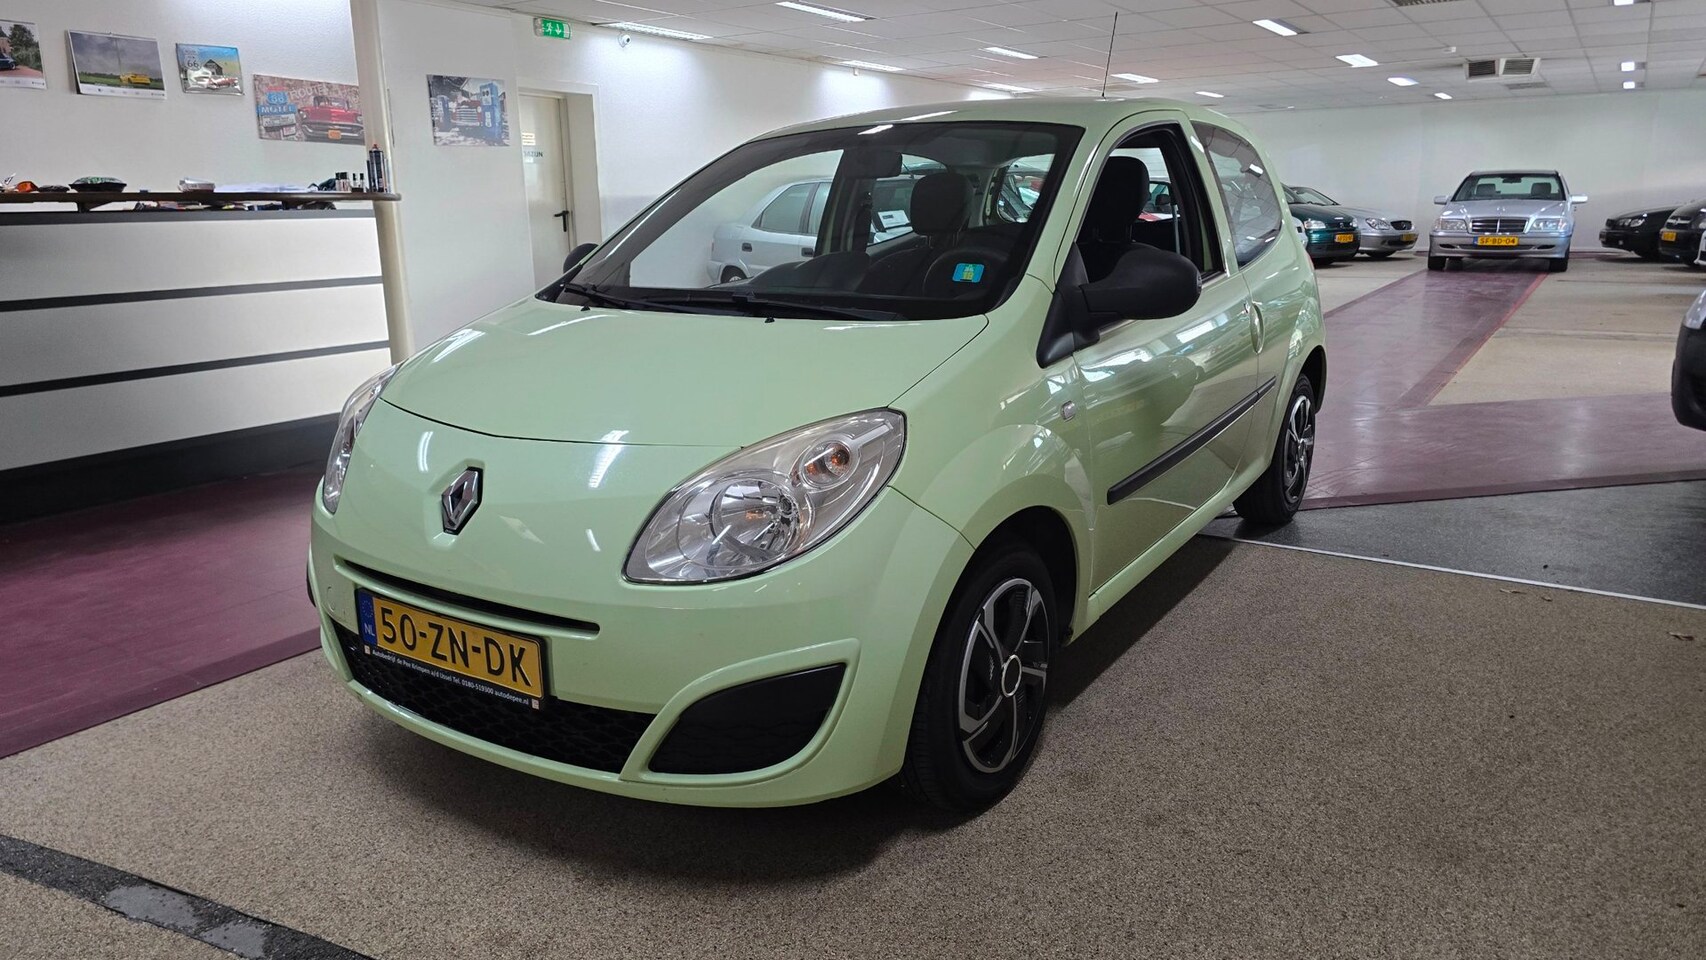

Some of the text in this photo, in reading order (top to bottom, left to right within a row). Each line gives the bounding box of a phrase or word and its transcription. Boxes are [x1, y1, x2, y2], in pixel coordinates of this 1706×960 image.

[187, 59, 200, 68] 66
[261, 105, 293, 114] MOTEL
[364, 624, 376, 638] NL
[381, 607, 533, 688] 50-ZN-DK
[396, 658, 403, 666] de
[411, 663, 431, 675] Krimpen
[431, 670, 440, 678] a/d
